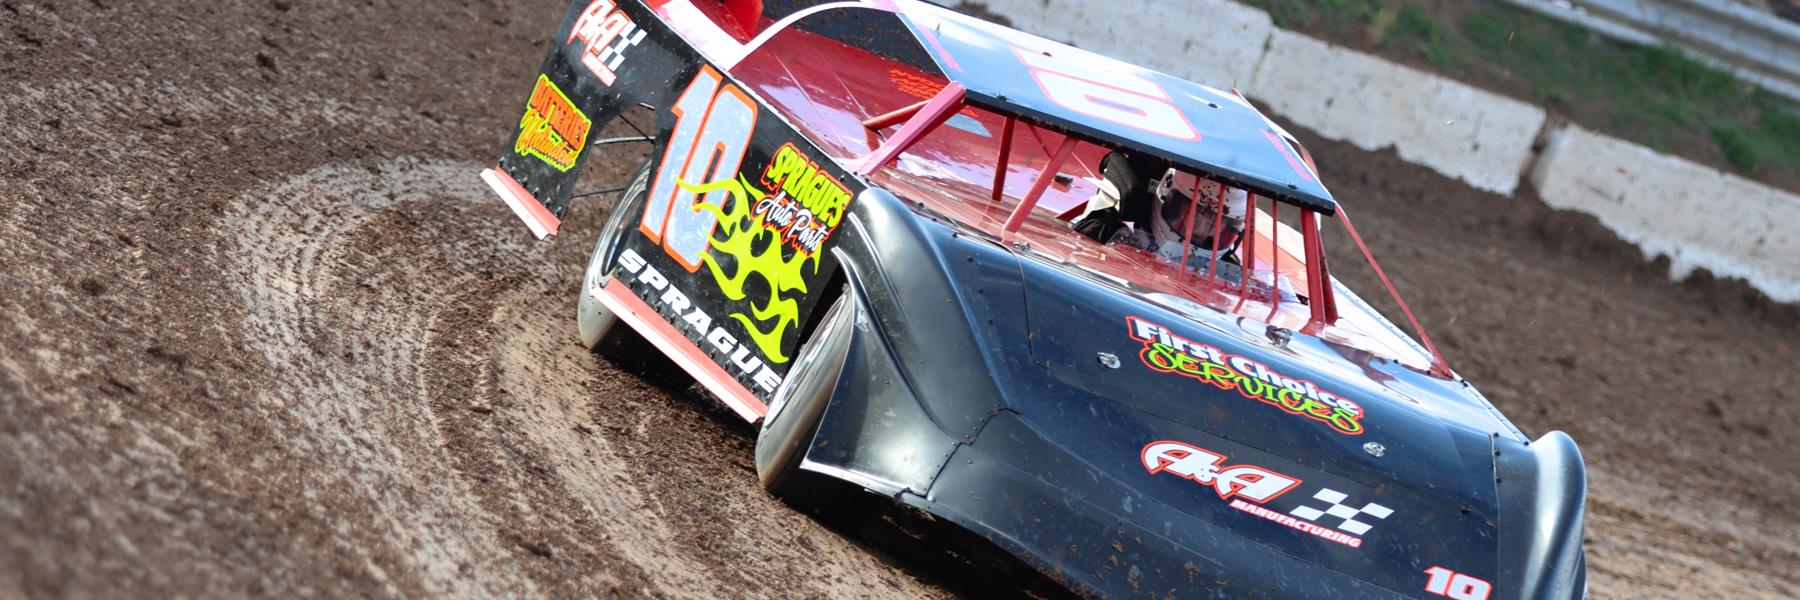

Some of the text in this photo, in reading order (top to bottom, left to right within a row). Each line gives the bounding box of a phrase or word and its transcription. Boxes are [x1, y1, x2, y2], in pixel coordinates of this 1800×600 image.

[639, 63, 758, 273] 10
[756, 191, 829, 251] Auto Parts
[617, 248, 783, 393] SPRAGUE
[1134, 318, 1360, 416] First Choice
[1147, 342, 1361, 432] SERVICES
[1229, 499, 1363, 548] MANUFACTURING
[1423, 565, 1493, 600] 10
